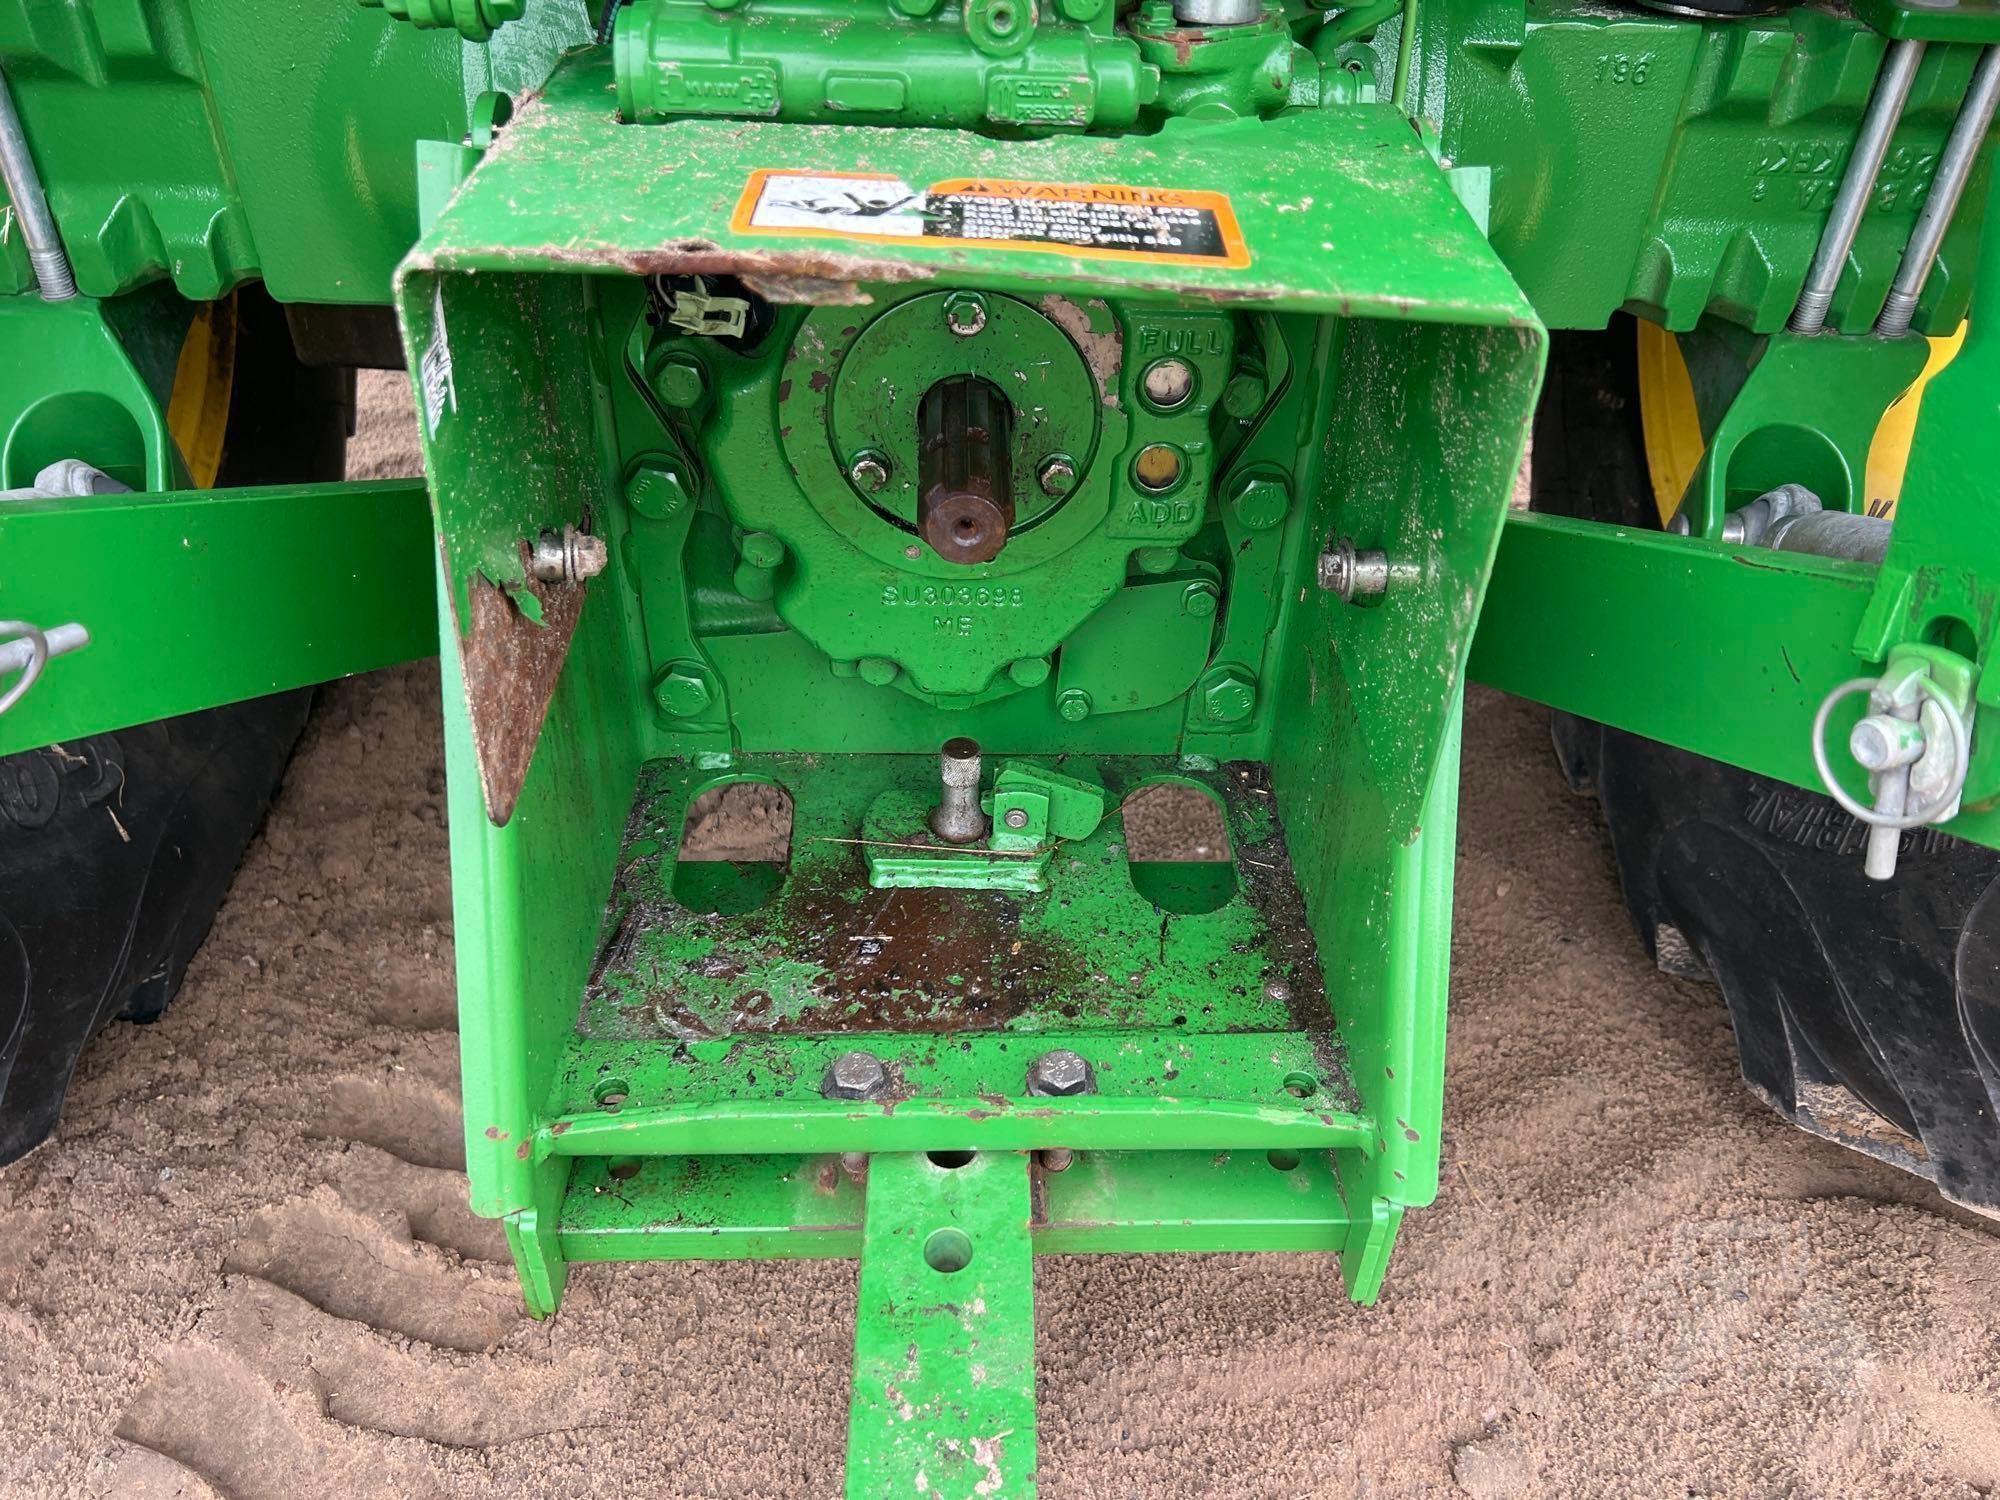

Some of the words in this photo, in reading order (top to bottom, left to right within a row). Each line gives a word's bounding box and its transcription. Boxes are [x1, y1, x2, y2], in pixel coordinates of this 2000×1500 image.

[1015, 103, 1088, 120] PRESSURE
[944, 194, 1011, 206] AVOID
[1014, 199, 1087, 211] INJURY
[1091, 203, 1154, 215] FROM
[1156, 206, 1200, 217] PTO
[998, 184, 1184, 205] WARNING
[1137, 323, 1223, 354] FULL
[1127, 500, 1196, 524] ADD
[880, 586, 1024, 607] SU303698
